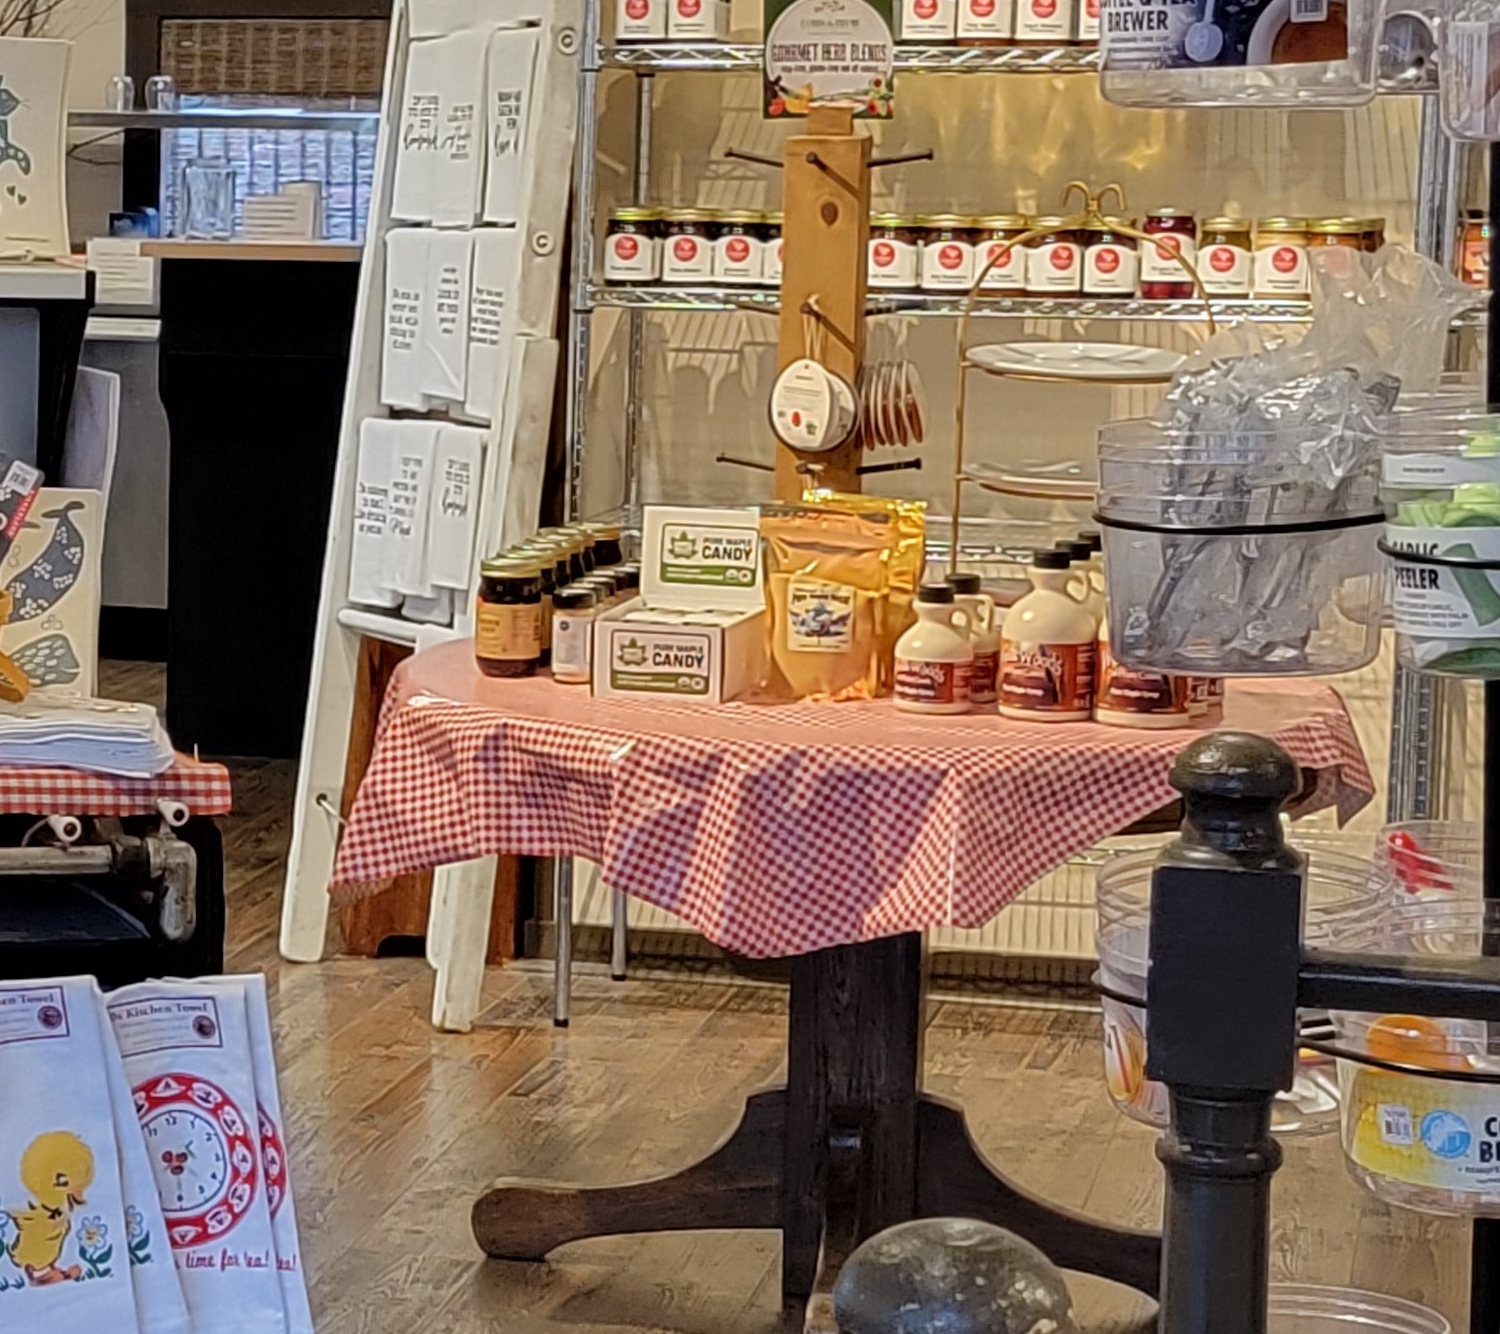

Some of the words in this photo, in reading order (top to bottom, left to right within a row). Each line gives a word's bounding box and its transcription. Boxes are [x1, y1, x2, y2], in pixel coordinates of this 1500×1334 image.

[1107, 10, 1169, 33] BREWER
[851, 43, 887, 62] BLENDS
[702, 545, 753, 561] CANDY
[1394, 566, 1440, 590] PEELER
[652, 652, 704, 668] CANDY
[21, 994, 54, 1004] Towel
[126, 1006, 174, 1019] Kitchen
[176, 1002, 208, 1013] Towel
